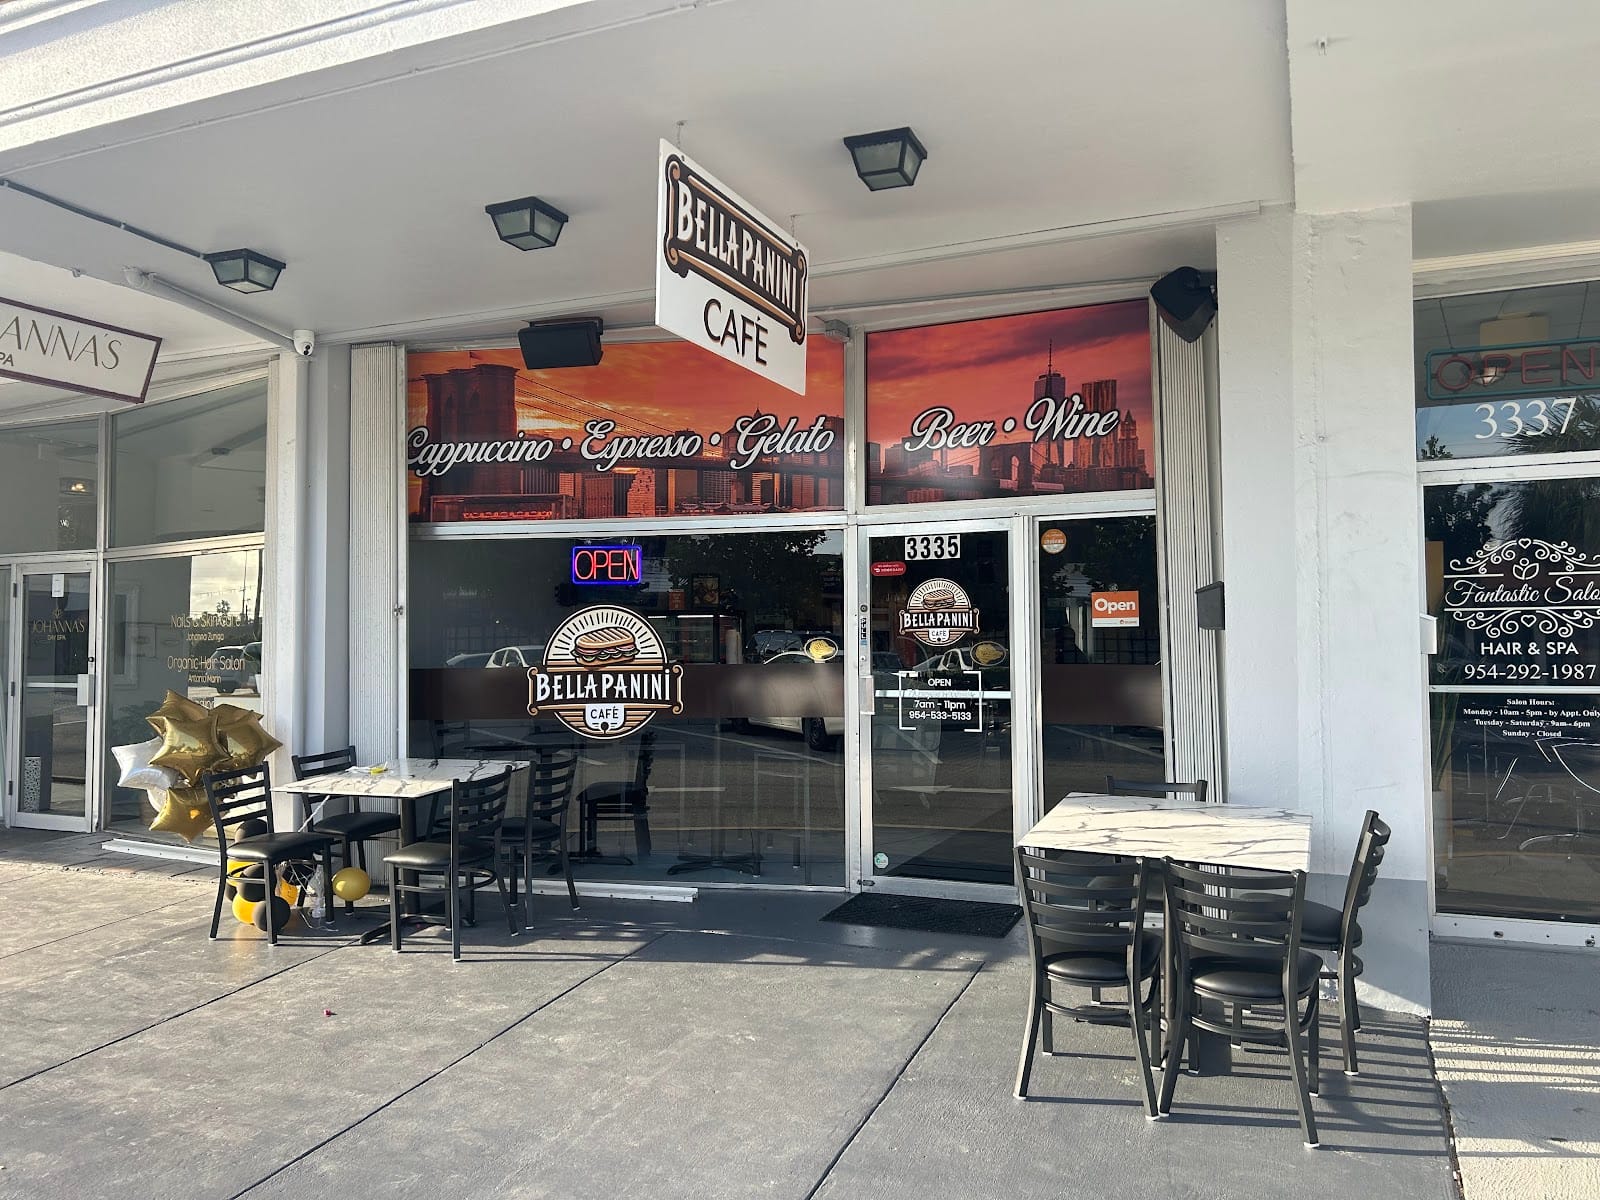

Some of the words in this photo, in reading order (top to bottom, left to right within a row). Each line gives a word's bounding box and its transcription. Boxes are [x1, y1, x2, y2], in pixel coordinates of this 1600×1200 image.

[703, 298, 769, 366] CAFÉ
[1436, 345, 1597, 392] OPEN
[904, 406, 997, 452] Beer
[1024, 393, 1121, 443] Wine
[1474, 396, 1577, 440] 3337
[407, 427, 554, 476] Cappuccino
[574, 419, 702, 472] Espresso
[730, 414, 836, 470] Gelato
[906, 535, 959, 560] 3335
[574, 550, 640, 580] OPEN
[1445, 579, 1541, 607] Fantastic
[1094, 597, 1136, 615] Open
[171, 613, 192, 628] Nails
[1481, 642, 1523, 655] HAIR
[1527, 642, 1541, 655] &
[1546, 641, 1579, 655] SPA
[168, 655, 198, 672] Organic
[200, 655, 218, 670] Hair
[220, 655, 246, 671] Salon
[1464, 663, 1597, 680] 954-292-1987
[927, 678, 952, 687] OPEN
[590, 705, 620, 719] CAFÉ
[914, 700, 935, 709] 7am
[944, 700, 966, 711] 11pm
[1463, 708, 1493, 717] Monday
[1526, 709, 1542, 718] 5pm
[1548, 710, 1559, 718] by
[1560, 710, 1581, 718] Appt.
[1582, 709, 1600, 718] Only
[909, 711, 972, 721] 954-533-5133
[1474, 719, 1503, 727] Tuesday
[1510, 719, 1544, 728] Saturday
[1550, 719, 1568, 727] 9am
[1573, 721, 1591, 729] 6pm
[1502, 730, 1530, 738] Sunday
